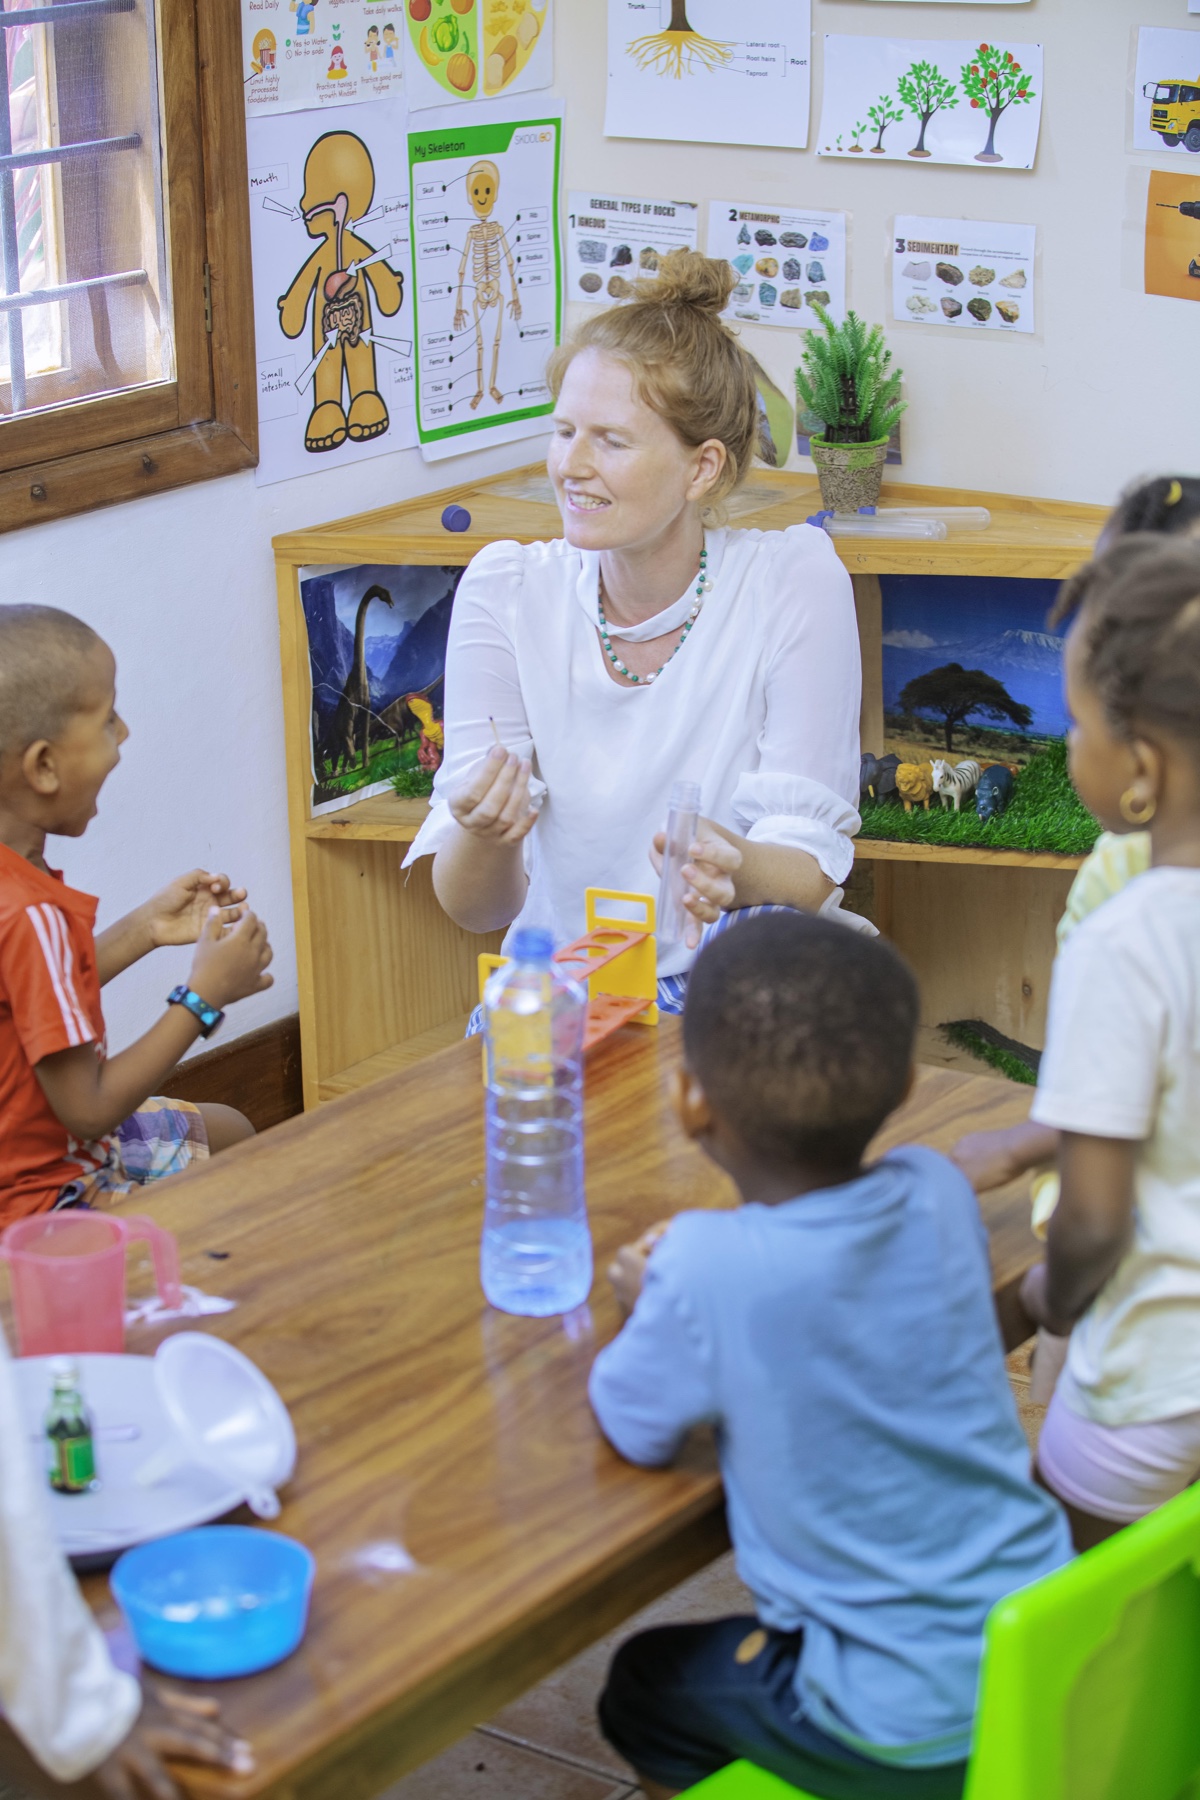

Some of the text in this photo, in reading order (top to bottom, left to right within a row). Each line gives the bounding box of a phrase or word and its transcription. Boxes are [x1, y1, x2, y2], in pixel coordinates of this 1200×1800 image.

[265, 0, 278, 12] Daily
[376, 6, 386, 16] daily
[265, 75, 280, 86] highly
[361, 76, 378, 85] Practice
[380, 74, 392, 84] good
[251, 86, 278, 95] processed
[316, 82, 336, 92] Practice
[337, 81, 352, 90] having
[373, 84, 390, 94] hygiene
[319, 89, 357, 102] growth Mindset
[414, 141, 465, 158] My Skeleton
[251, 172, 278, 187] Mouth
[590, 199, 676, 217] GENERAL TYPES OF ROCKS
[422, 217, 443, 225] Vertebra
[569, 214, 606, 228] 1 IGNEOUS
[729, 209, 737, 221] 2
[740, 212, 780, 223] METAMORPHIC
[423, 245, 445, 253] Humerus
[895, 238, 959, 256] 3 SEDIMENTARY
[427, 336, 446, 344] Sacrum
[260, 368, 282, 380] Small
[262, 380, 290, 393] intestine
